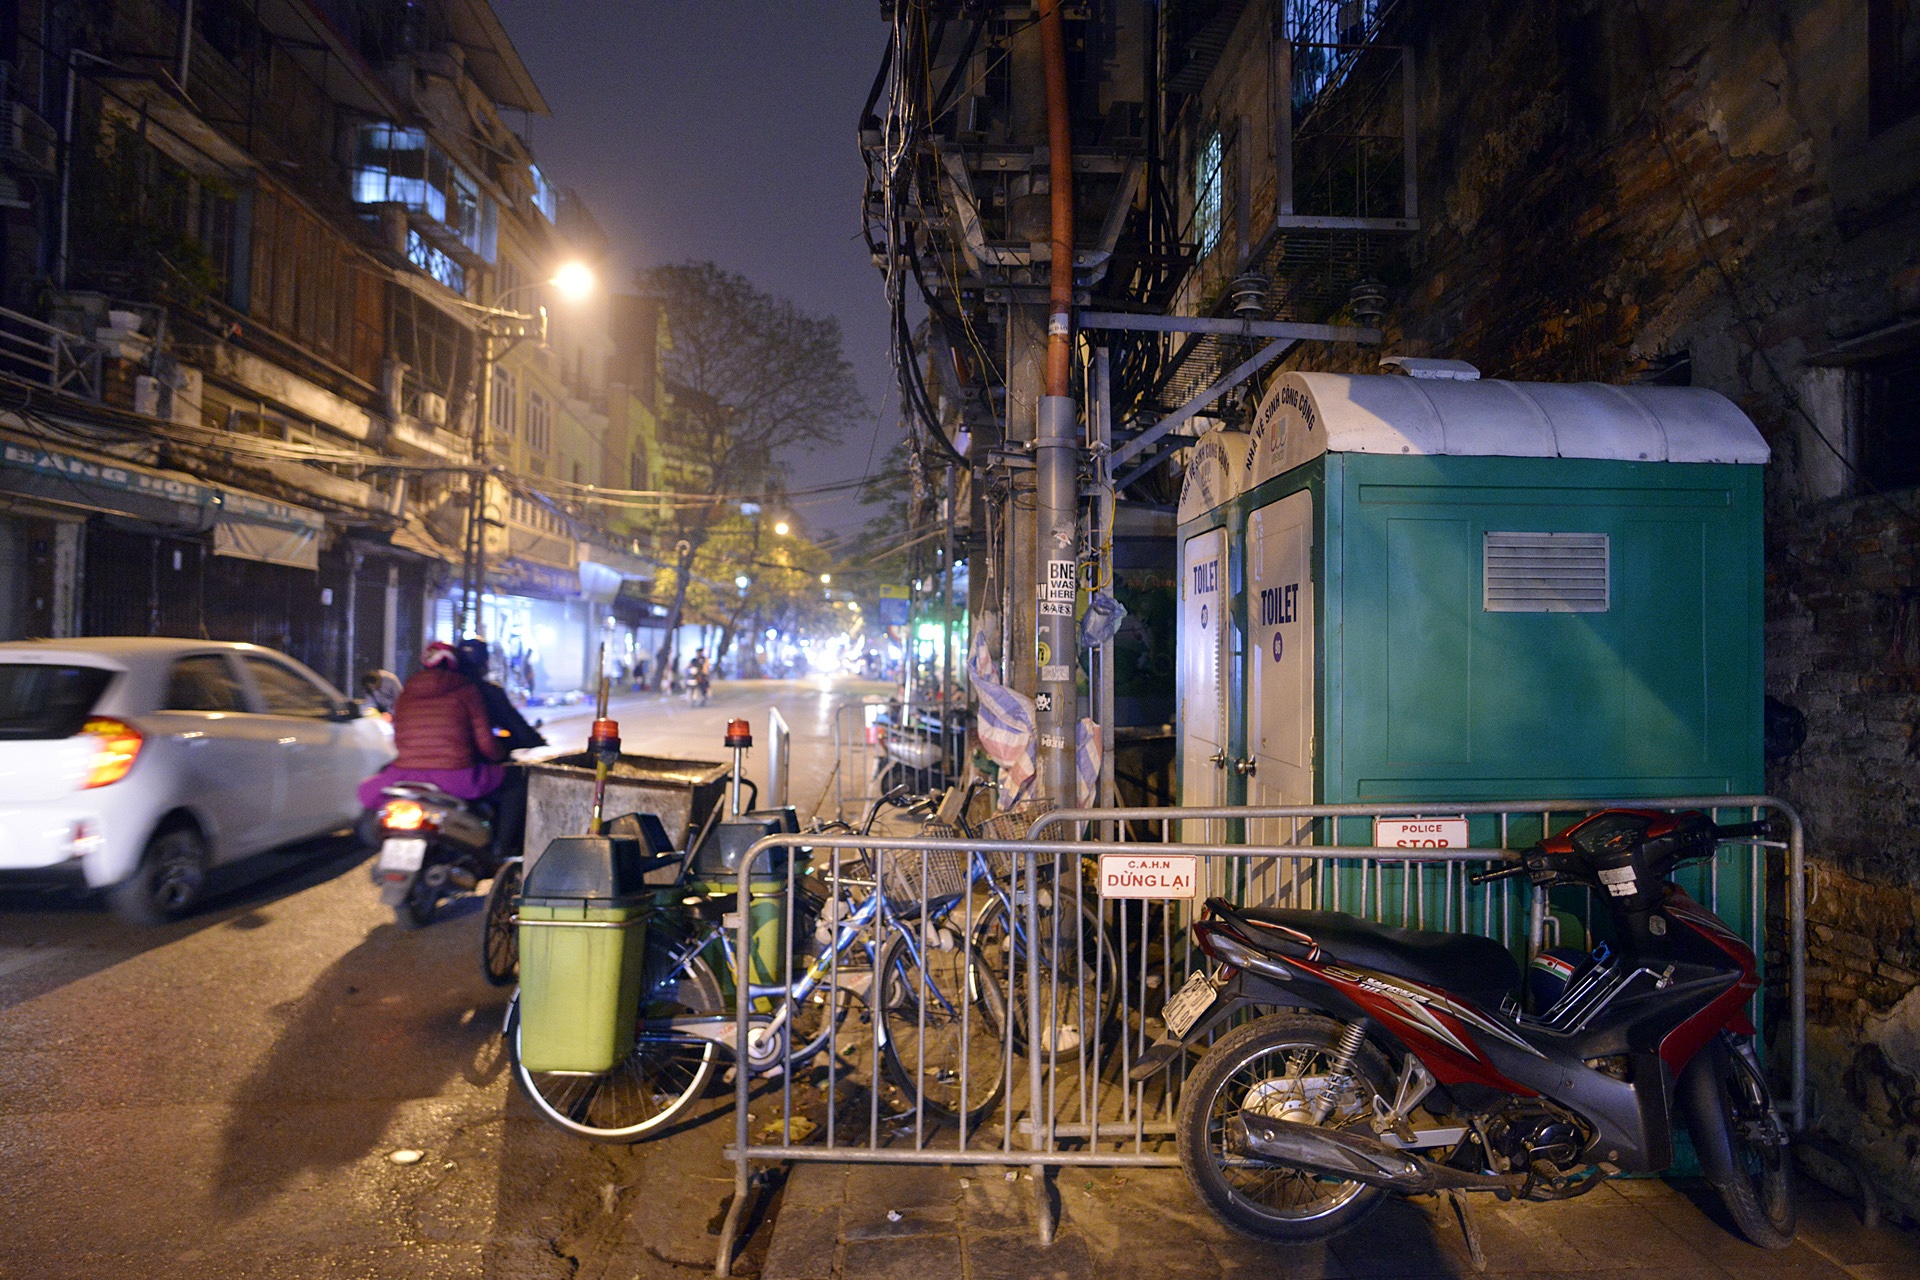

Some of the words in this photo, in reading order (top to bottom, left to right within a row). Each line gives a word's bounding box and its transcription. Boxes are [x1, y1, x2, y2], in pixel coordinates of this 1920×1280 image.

[1265, 392, 1280, 424] SINH
[1281, 384, 1299, 408] CÔNG
[1051, 563, 1074, 580] BNE
[1193, 560, 1218, 595] TOILET
[1051, 580, 1074, 589] WAS
[1050, 590, 1074, 599] HERE
[1261, 583, 1298, 626] TOILET
[1402, 824, 1442, 832] POLICE
[1128, 860, 1170, 869] C.A.H.N
[1108, 870, 1157, 887] DỪNG
[1161, 875, 1189, 890] LẠI
